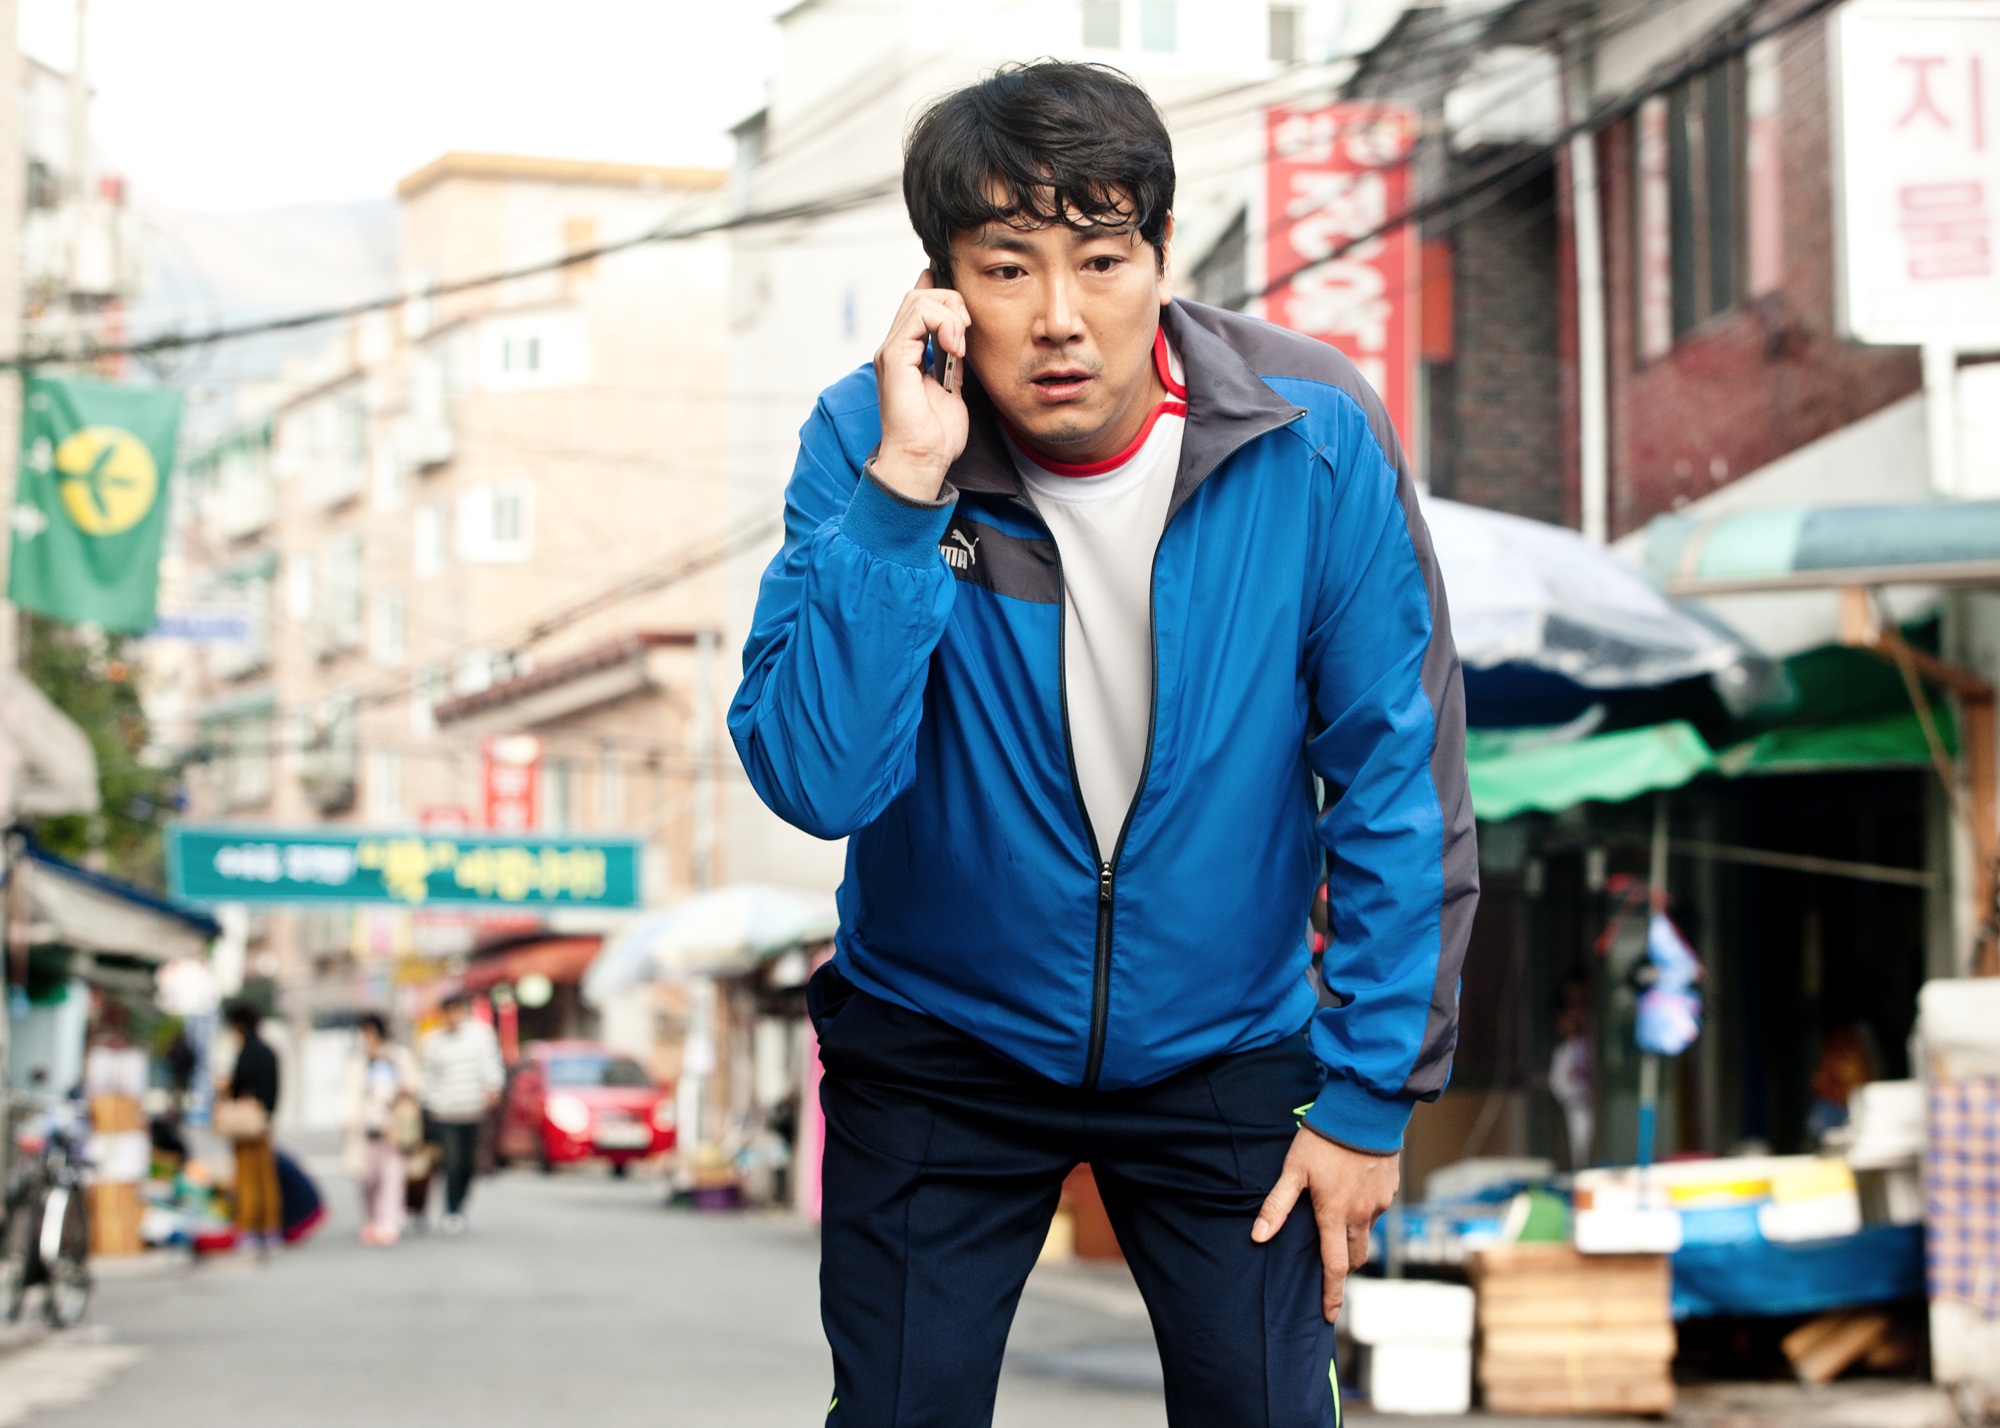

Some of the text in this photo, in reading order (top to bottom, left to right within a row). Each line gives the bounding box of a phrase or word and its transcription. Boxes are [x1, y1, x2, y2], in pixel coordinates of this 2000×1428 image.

[1894, 53, 1992, 282] 지물
[1286, 167, 1393, 399] 정육
[938, 544, 968, 570] MA
